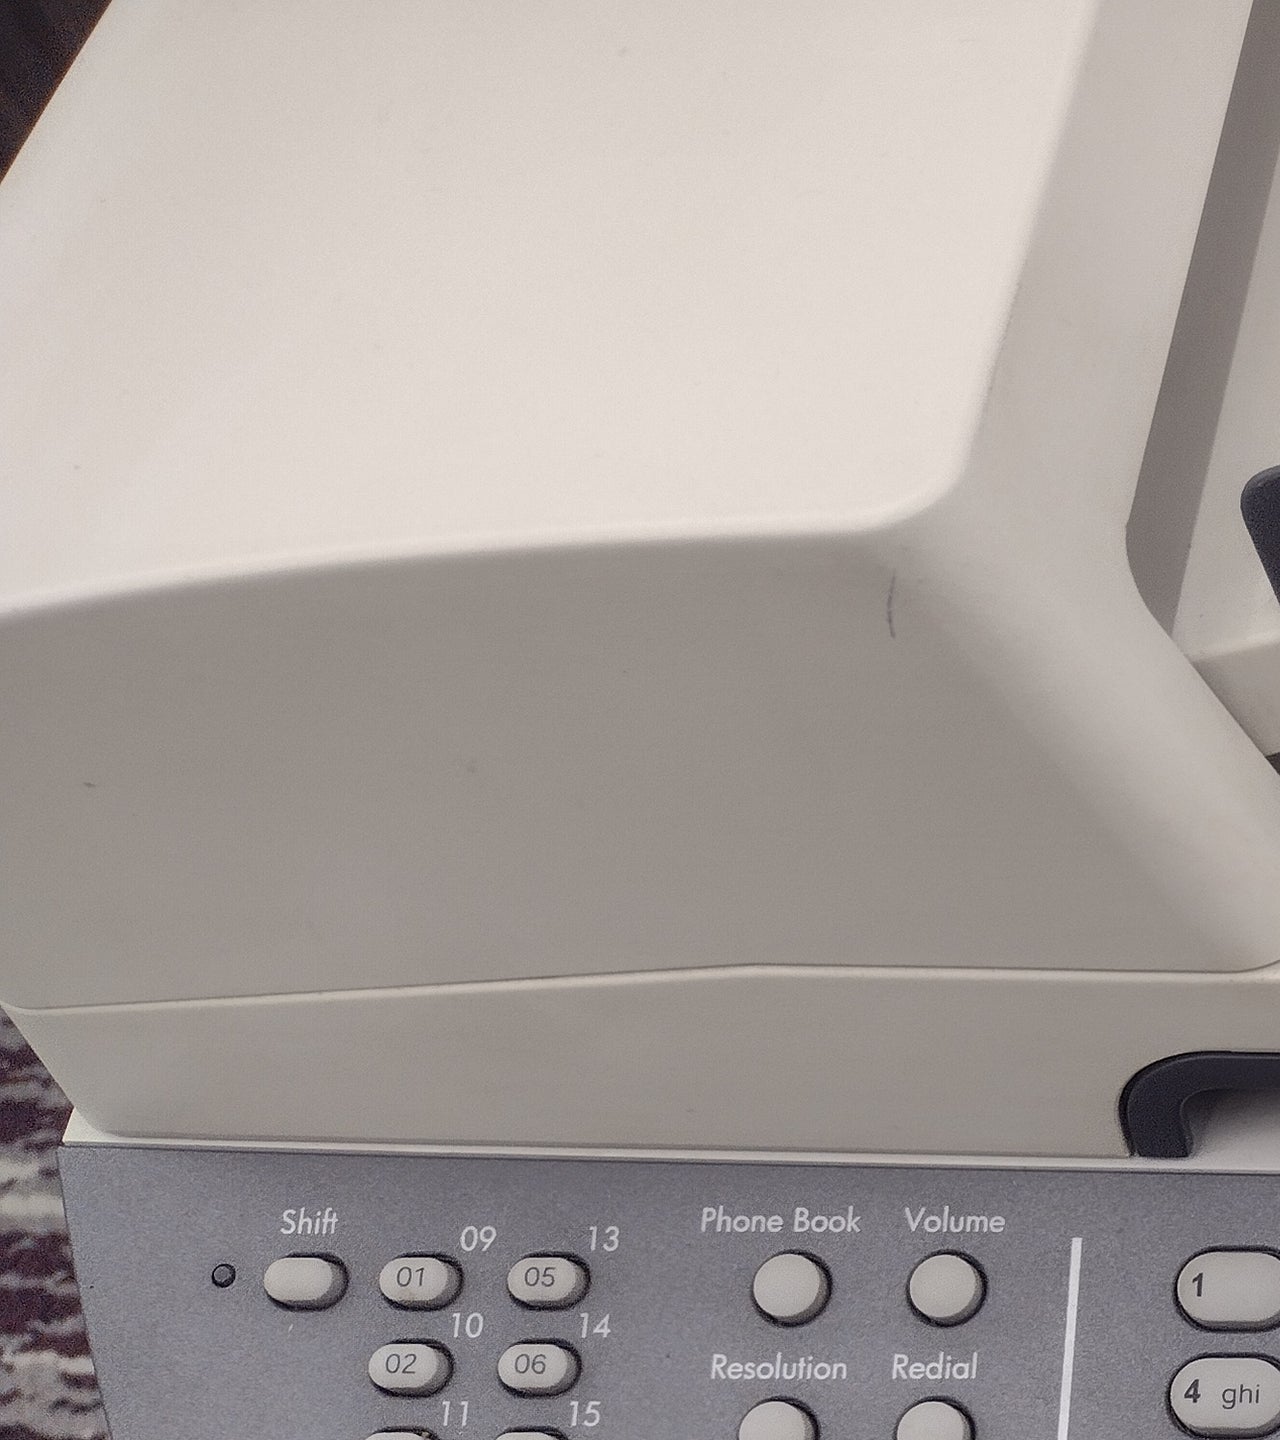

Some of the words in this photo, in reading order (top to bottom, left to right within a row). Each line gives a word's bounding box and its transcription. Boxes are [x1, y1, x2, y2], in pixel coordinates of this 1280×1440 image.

[280, 1207, 339, 1235] Shift
[700, 1205, 784, 1233] Phone
[793, 1205, 861, 1233] Book
[904, 1205, 1006, 1233] Volume
[460, 1225, 497, 1252] 09
[589, 1225, 620, 1252] 13
[396, 1266, 425, 1288] 01
[524, 1266, 556, 1288] 05
[1192, 1272, 1204, 1298] 1
[452, 1312, 484, 1339] 10
[580, 1312, 611, 1339] 14
[385, 1353, 417, 1375] 02
[514, 1353, 547, 1375] 06
[710, 1351, 847, 1380] Resolution
[891, 1351, 978, 1380] Redial
[1183, 1378, 1201, 1404] 4
[1221, 1383, 1260, 1410] ghi
[442, 1400, 469, 1427] 11
[570, 1400, 601, 1428] 15
